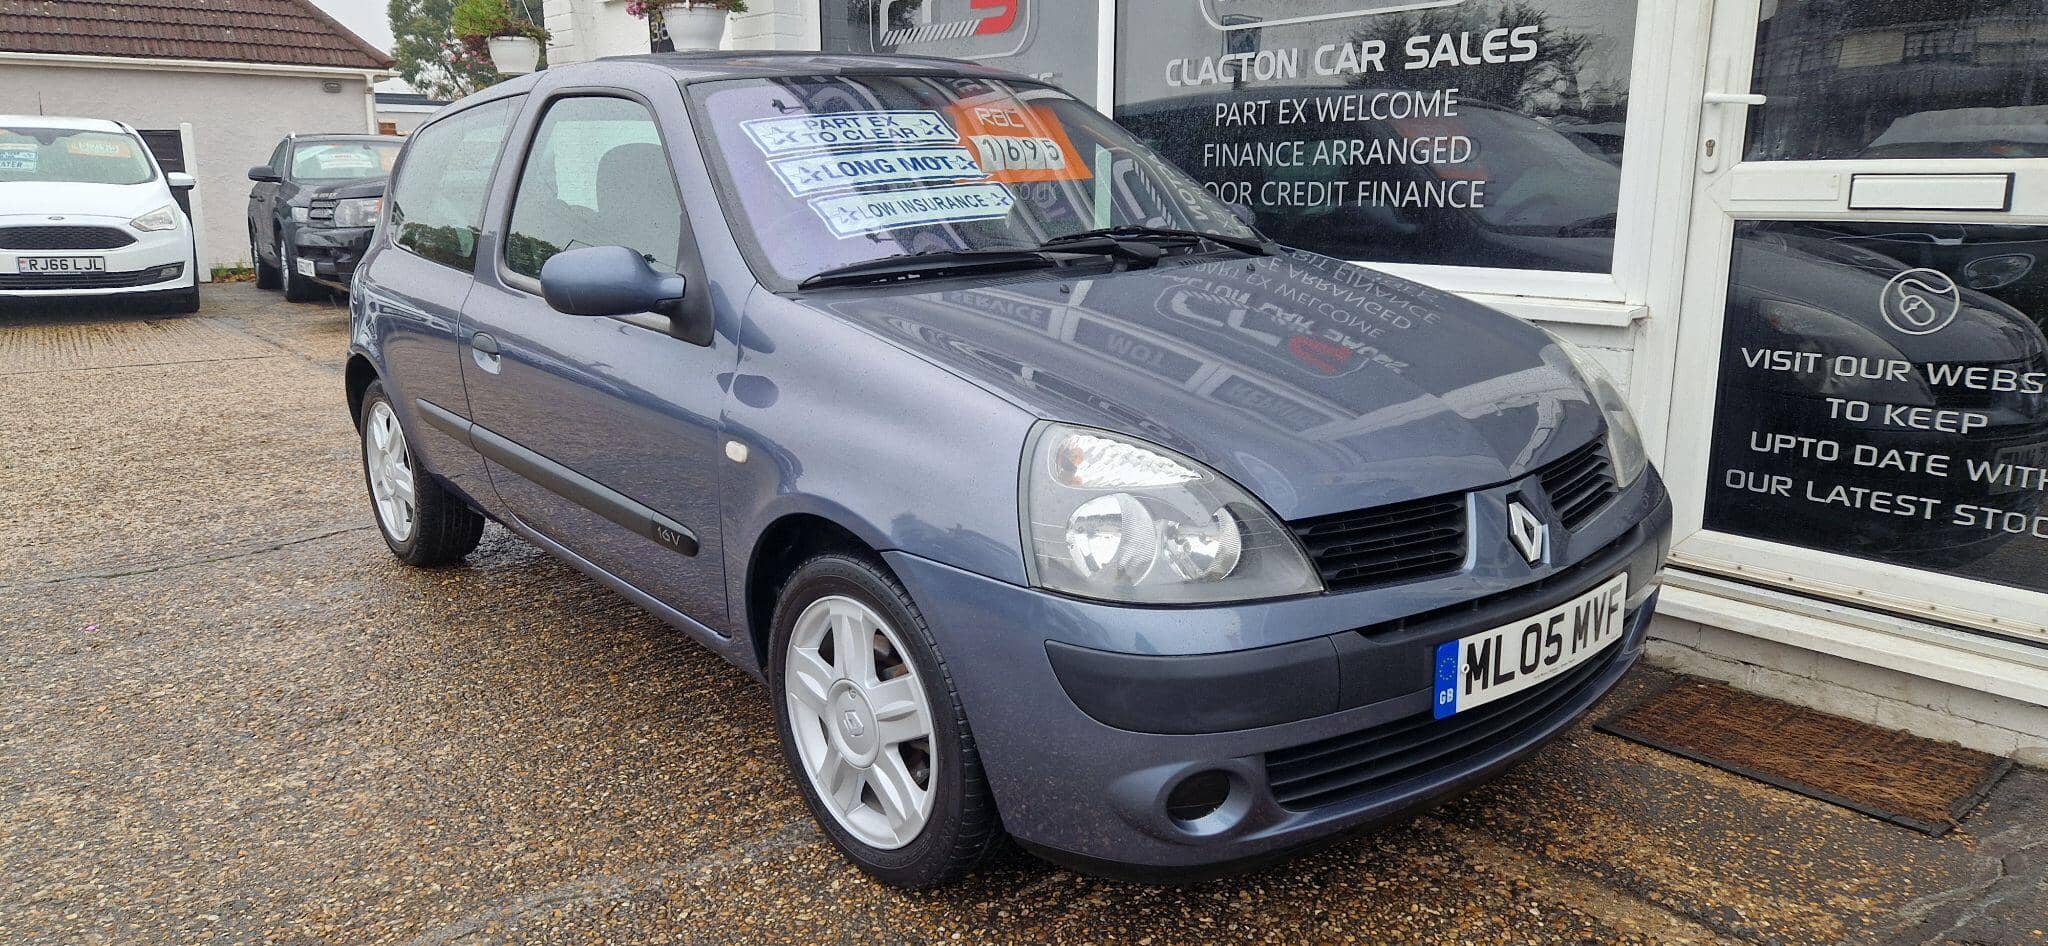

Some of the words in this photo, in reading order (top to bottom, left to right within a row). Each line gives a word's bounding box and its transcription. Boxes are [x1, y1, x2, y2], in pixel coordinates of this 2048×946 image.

[1165, 47, 1298, 87] CLACTON
[1314, 39, 1387, 76] CAR
[1404, 25, 1539, 70] SALES
[803, 115, 860, 131] PART
[868, 115, 899, 127] EX
[1215, 100, 1271, 127] PART
[1278, 97, 1308, 124] EX
[1314, 88, 1459, 122] WELCOME
[801, 131, 837, 144] TO
[843, 127, 919, 142] CLEAR
[1204, 141, 1304, 167] FINANCE
[1312, 135, 1472, 166] ARRANGED
[821, 158, 898, 180] LONG
[899, 155, 951, 172] MOT
[856, 201, 900, 219] LOW
[900, 193, 989, 215] INSURANCE
[1203, 182, 1257, 206] OOR
[1260, 180, 1349, 207] CREDIT
[1357, 179, 1487, 209] FINANCE
[28, 258, 69, 271] RJ66
[73, 258, 103, 271] LJL
[1741, 347, 1822, 374] VISIT
[1834, 354, 1912, 382] OUR
[1825, 397, 1868, 422] TO
[1883, 405, 1988, 434] KEEP
[1750, 431, 1839, 462] UPTO
[1854, 444, 1951, 477] DATE
[1725, 469, 1793, 498] OUR
[1805, 480, 1941, 520] LATEST
[657, 526, 681, 546] 16V
[1464, 612, 1565, 696] ML05
[1571, 581, 1624, 655] MVF
[1439, 688, 1454, 705] GB
